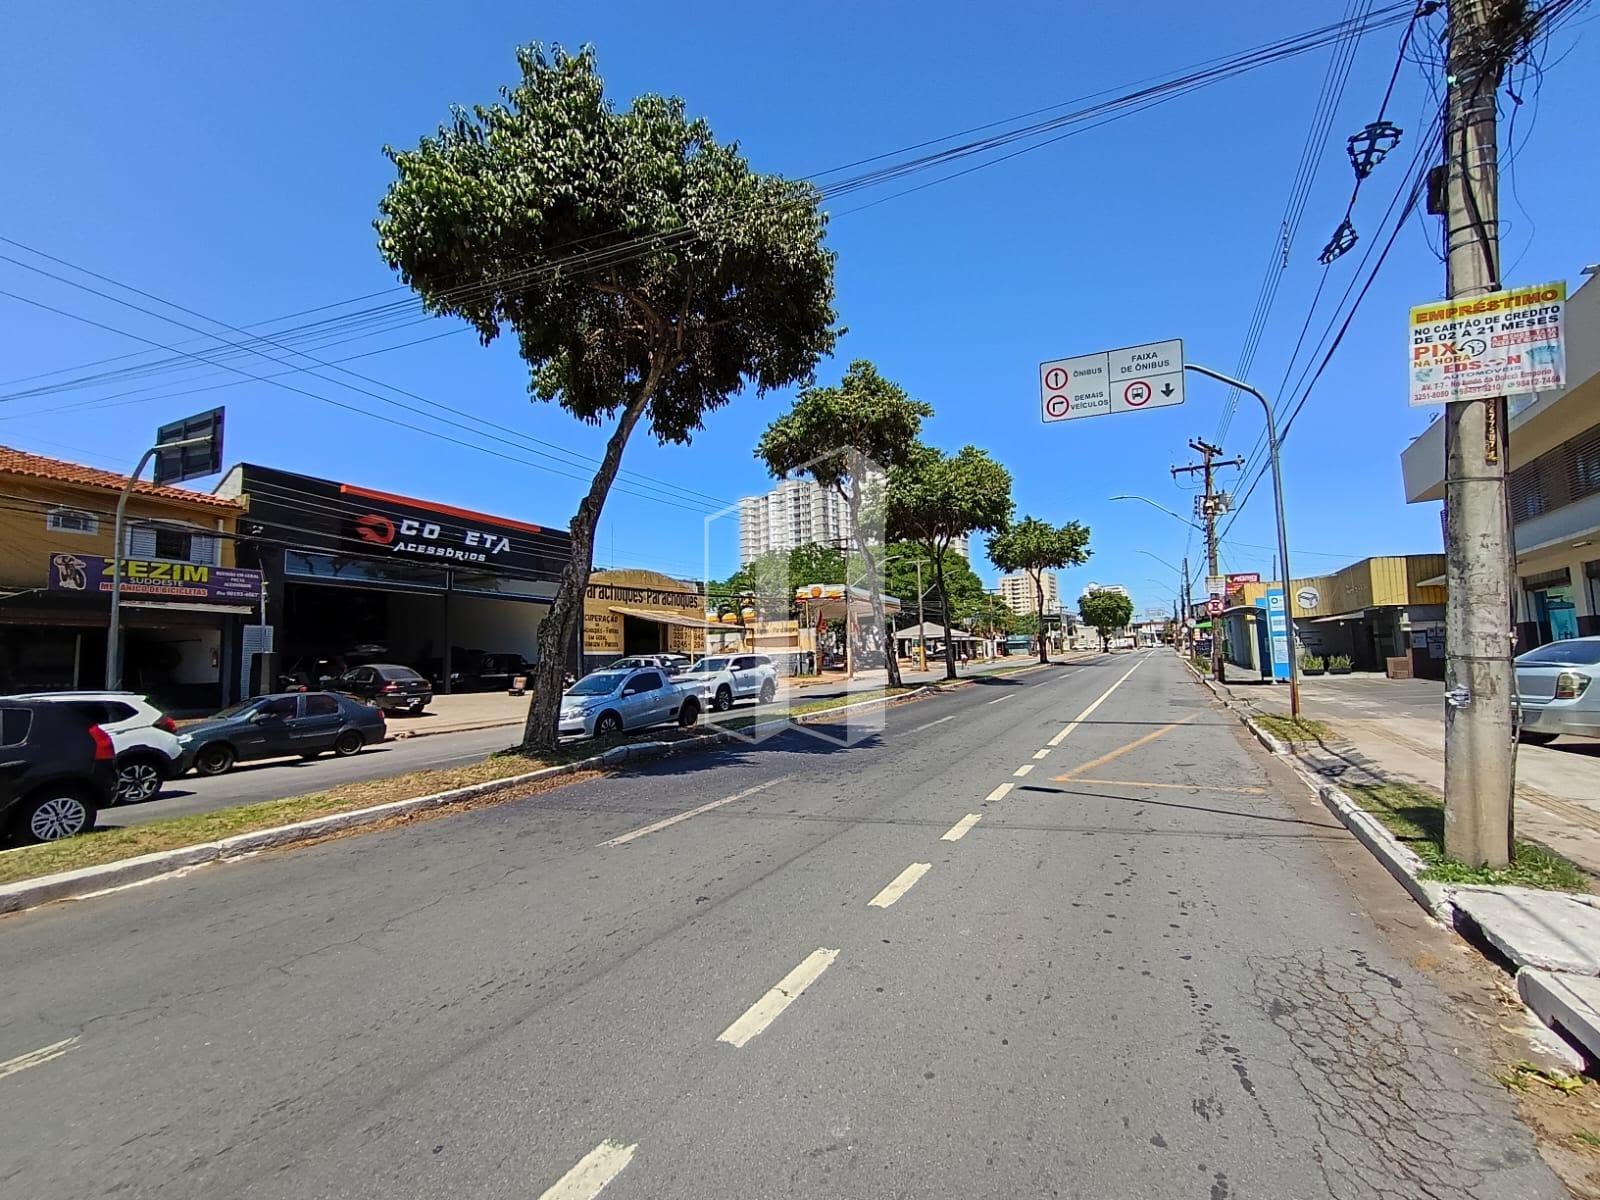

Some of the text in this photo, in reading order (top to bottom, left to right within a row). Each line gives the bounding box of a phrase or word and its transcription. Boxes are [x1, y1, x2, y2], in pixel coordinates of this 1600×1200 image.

[1416, 289, 1558, 324] EMPRÉSTIMO
[1414, 305, 1560, 337] NO CARTÃO DE CRÉDITO
[1414, 315, 1559, 344] DE 02 A 21 MESES
[1131, 351, 1158, 363] FAIXA
[1414, 341, 1458, 360] PIX
[1120, 359, 1170, 374] DE ÔNIBUS
[1413, 353, 1472, 368] NA HORA
[1073, 367, 1102, 378] ÔNIBUS
[1070, 399, 1109, 411] VEÍCULOS
[1074, 391, 1104, 402] DEMAIS
[102, 558, 208, 582] ZEZIM
[586, 583, 643, 605] arachoques
